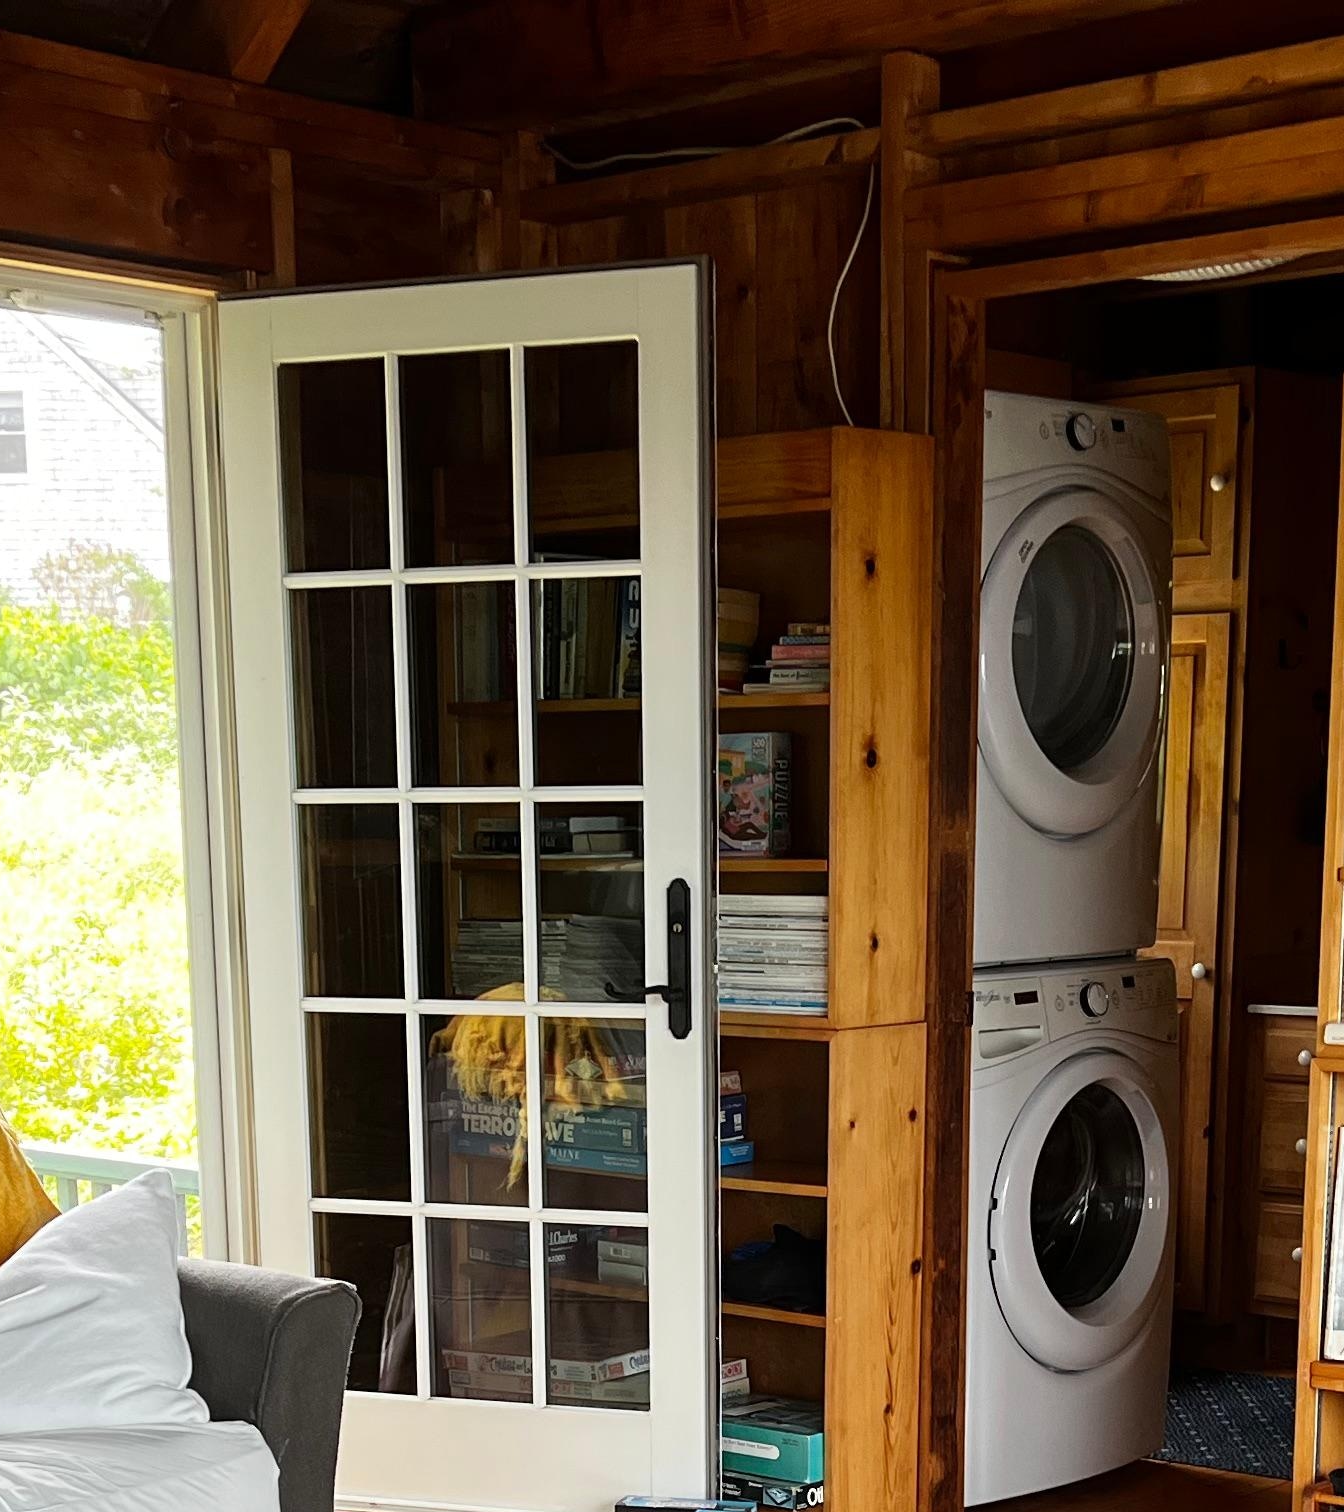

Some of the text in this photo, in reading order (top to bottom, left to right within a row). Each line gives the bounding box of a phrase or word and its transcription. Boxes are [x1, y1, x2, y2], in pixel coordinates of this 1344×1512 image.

[773, 759, 790, 820] PUZZLE
[462, 1113, 575, 1144] TERRO AVE
